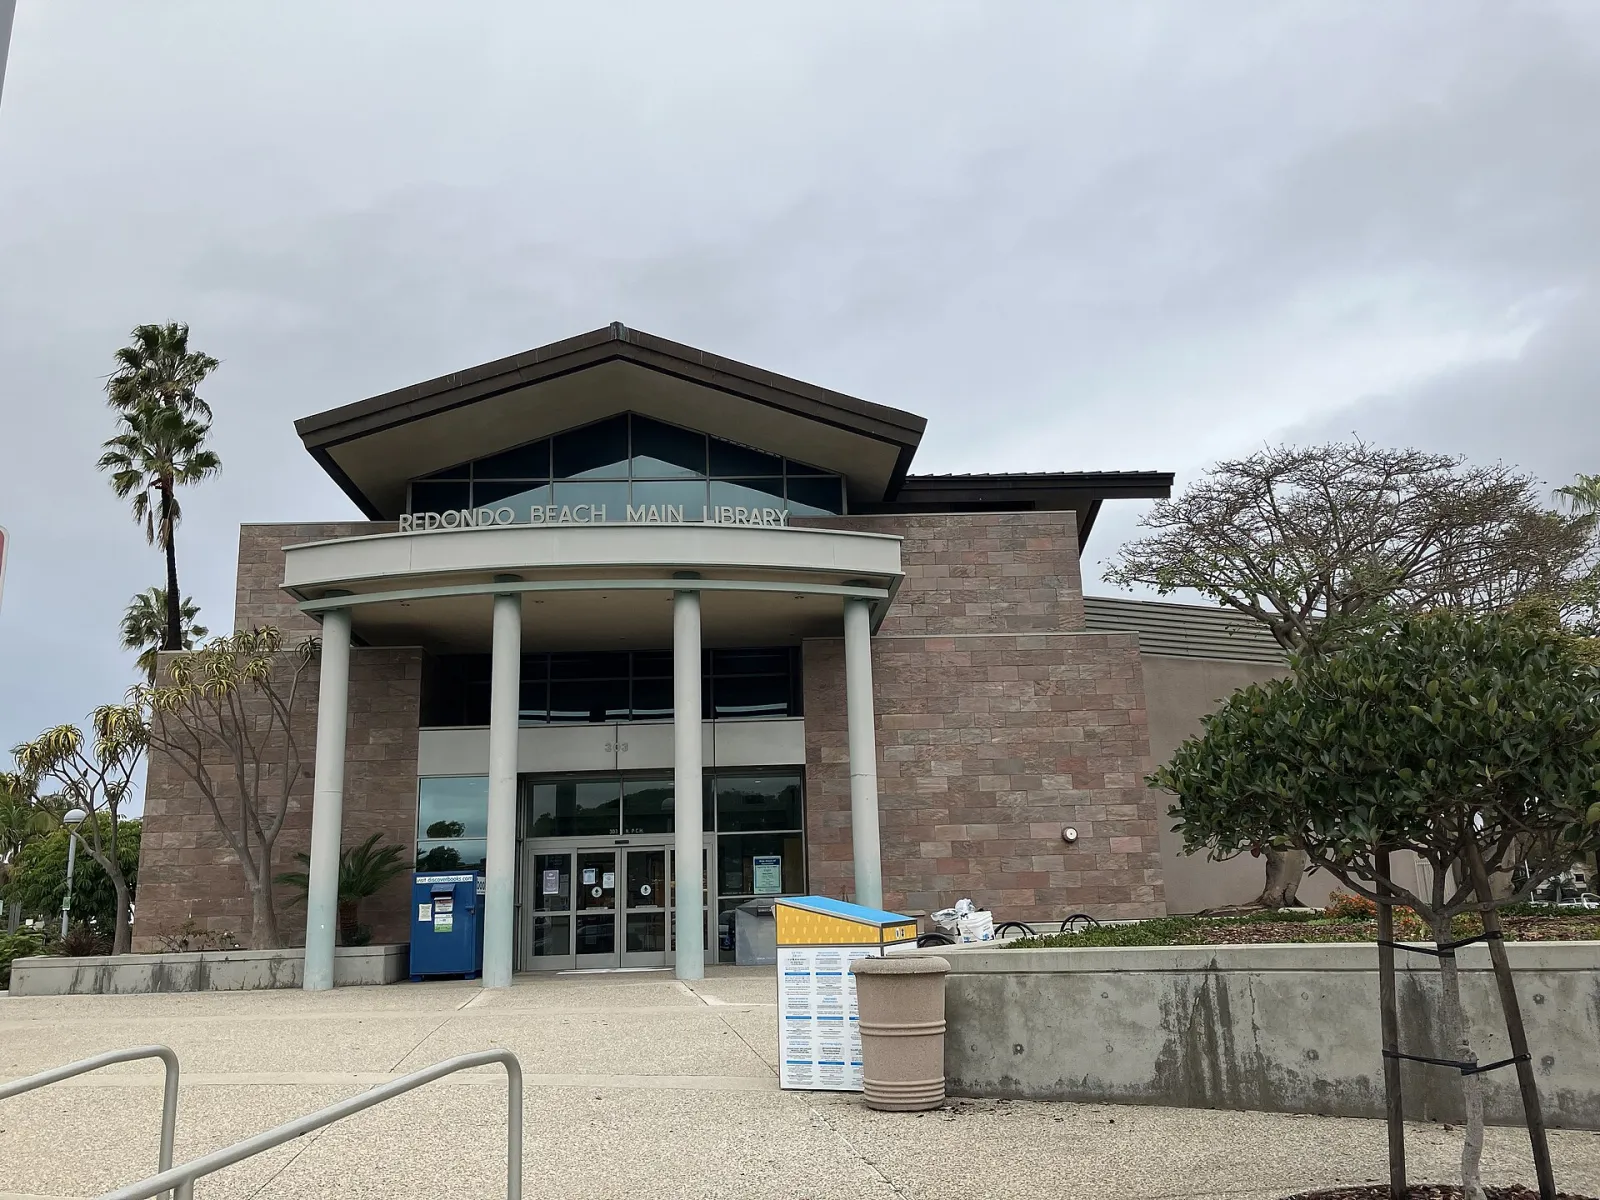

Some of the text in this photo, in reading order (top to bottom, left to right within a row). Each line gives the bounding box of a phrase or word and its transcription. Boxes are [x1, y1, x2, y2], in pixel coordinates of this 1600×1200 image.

[399, 504, 788, 532] REDONDO BEACH MAIN LIBRARY
